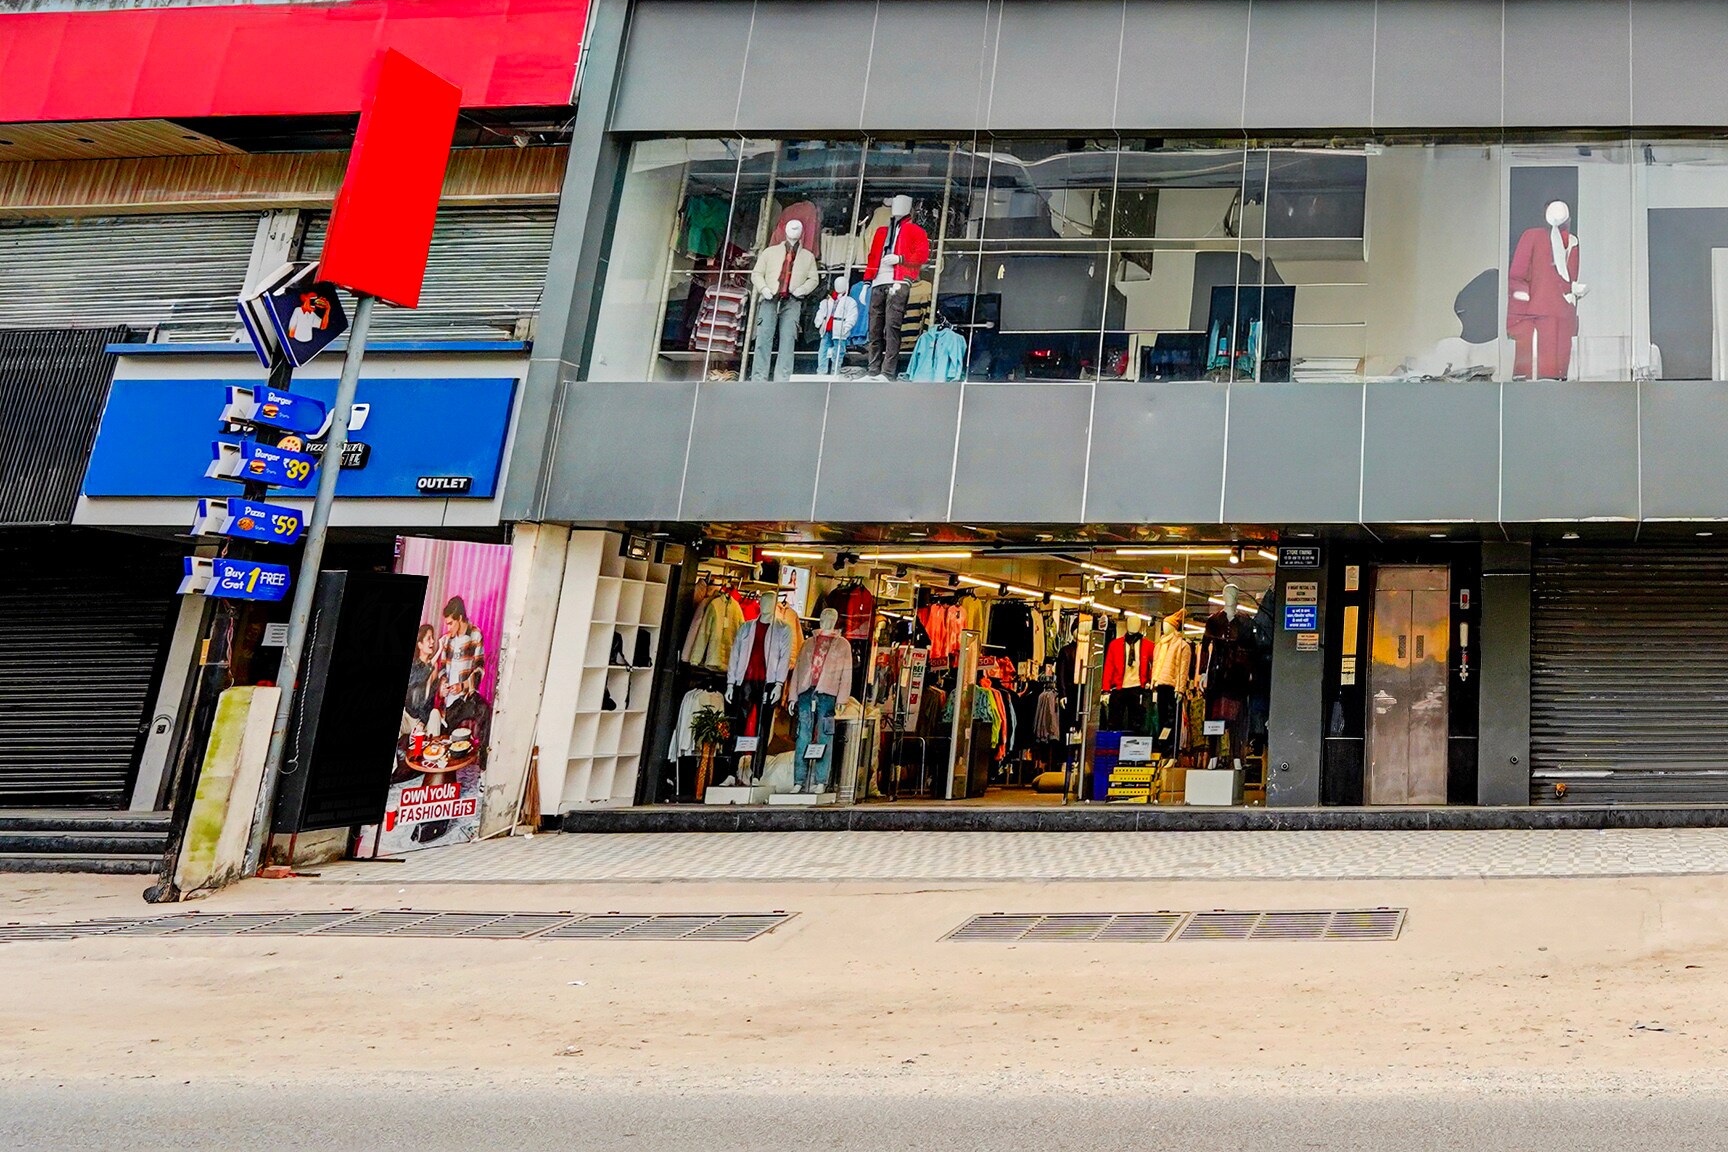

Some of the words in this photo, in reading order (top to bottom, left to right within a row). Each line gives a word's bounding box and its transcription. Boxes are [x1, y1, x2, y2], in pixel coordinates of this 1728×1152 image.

[417, 477, 468, 489] OUTLET
[244, 506, 266, 518] Pizza
[224, 566, 245, 580] Buy
[245, 567, 262, 593] 1
[260, 571, 286, 586] FREE
[221, 578, 245, 590] Get
[402, 785, 430, 804] OWN
[430, 782, 457, 801] YOUR
[399, 803, 451, 823] FASHION
[453, 800, 473, 816] FITS
